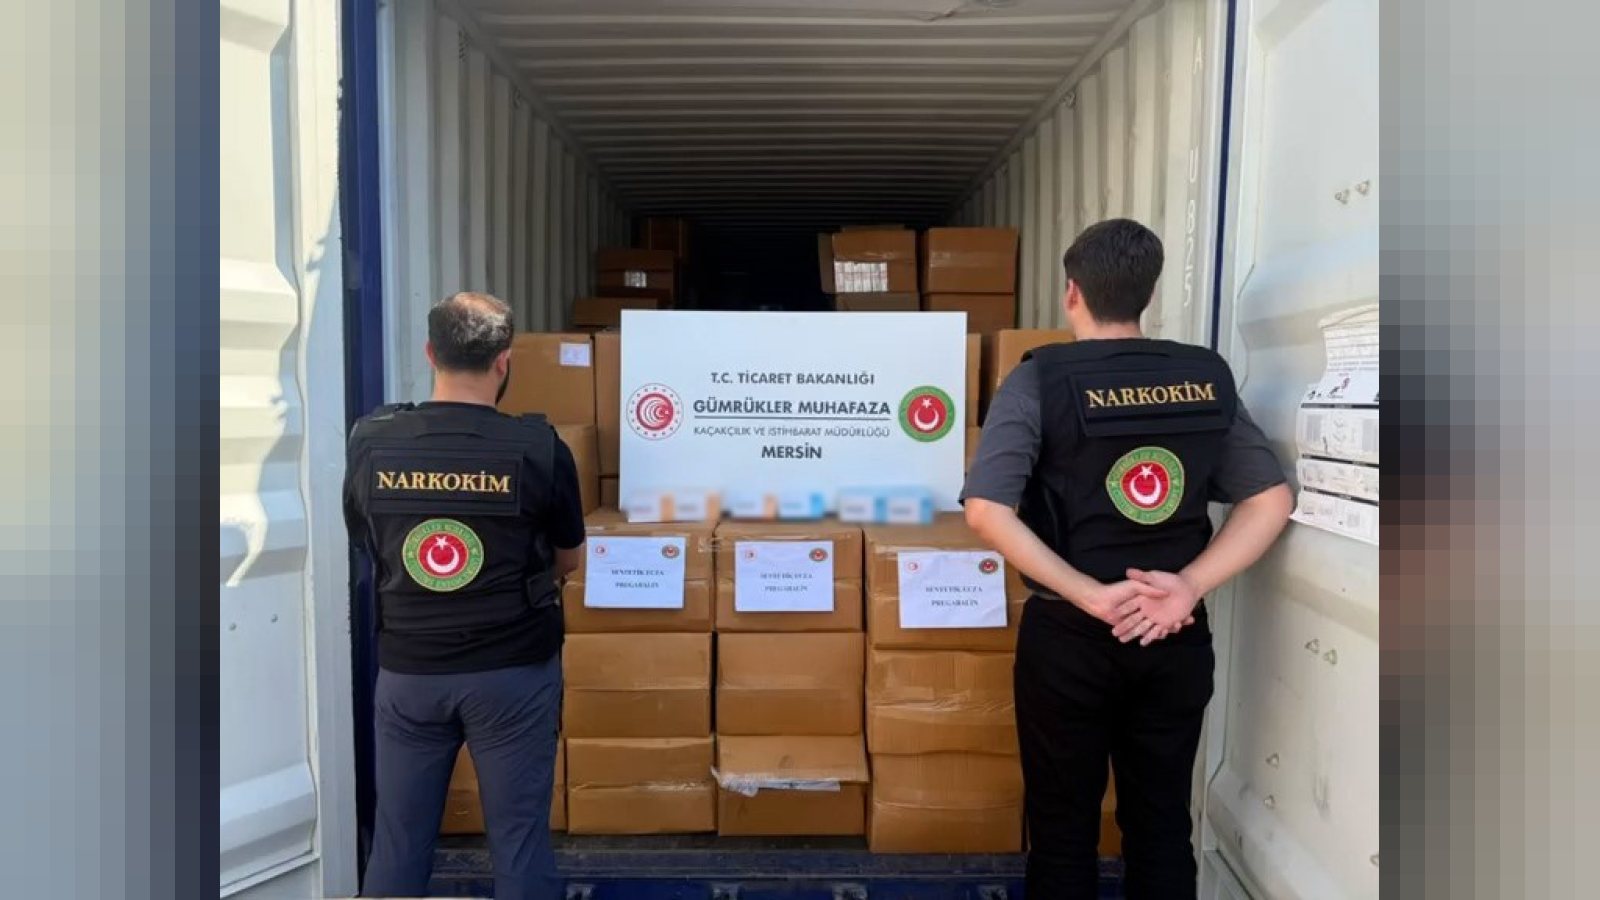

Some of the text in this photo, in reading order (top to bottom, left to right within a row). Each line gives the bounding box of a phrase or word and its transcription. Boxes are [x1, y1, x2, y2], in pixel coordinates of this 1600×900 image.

[711, 369, 875, 385] T.C. TİCARET BAKANLIĞI
[693, 394, 892, 415] GÜMRÜKLER MUHAFAZA
[1085, 381, 1216, 409] NARKOKİM
[753, 426, 766, 437] VE
[761, 441, 823, 459] MERSİN
[376, 469, 513, 493] NARKOKİM
